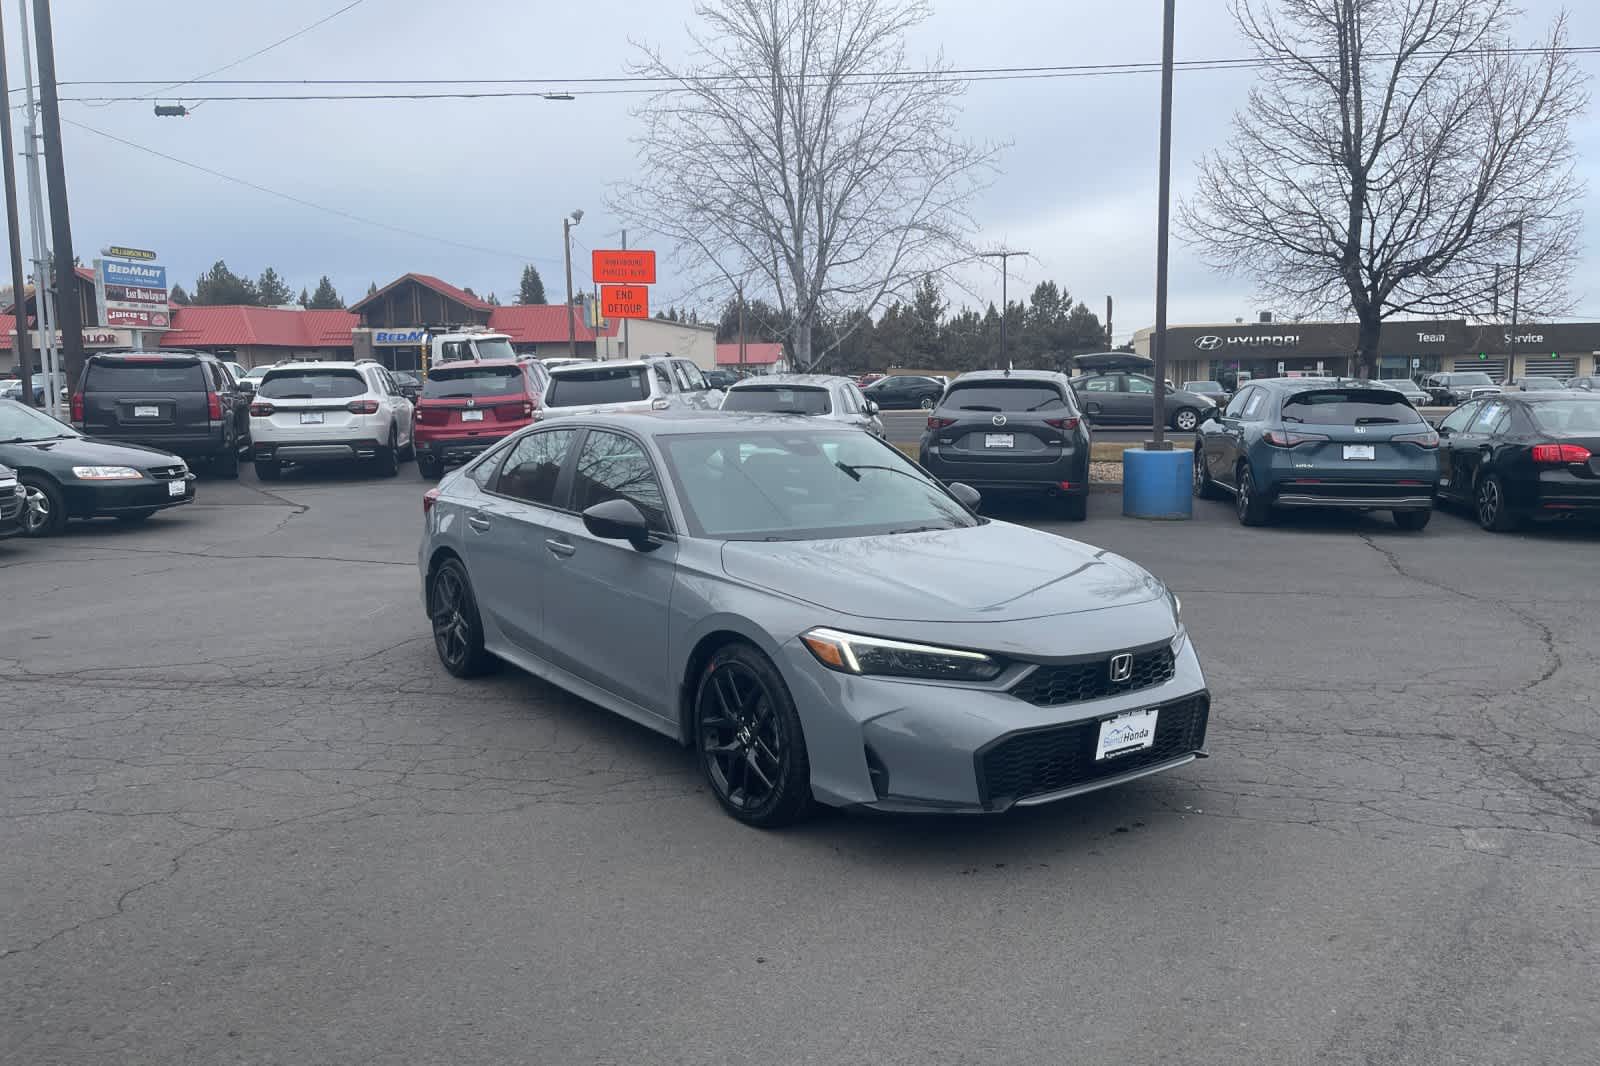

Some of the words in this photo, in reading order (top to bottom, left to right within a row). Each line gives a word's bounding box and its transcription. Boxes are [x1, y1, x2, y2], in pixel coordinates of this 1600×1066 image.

[615, 290, 633, 300] END
[608, 303, 642, 313] DETOUR
[1227, 335, 1300, 346] HYUNDAI
[1417, 332, 1446, 343] Team
[1504, 333, 1544, 343] Srvice
[1123, 728, 1149, 742] Honda
